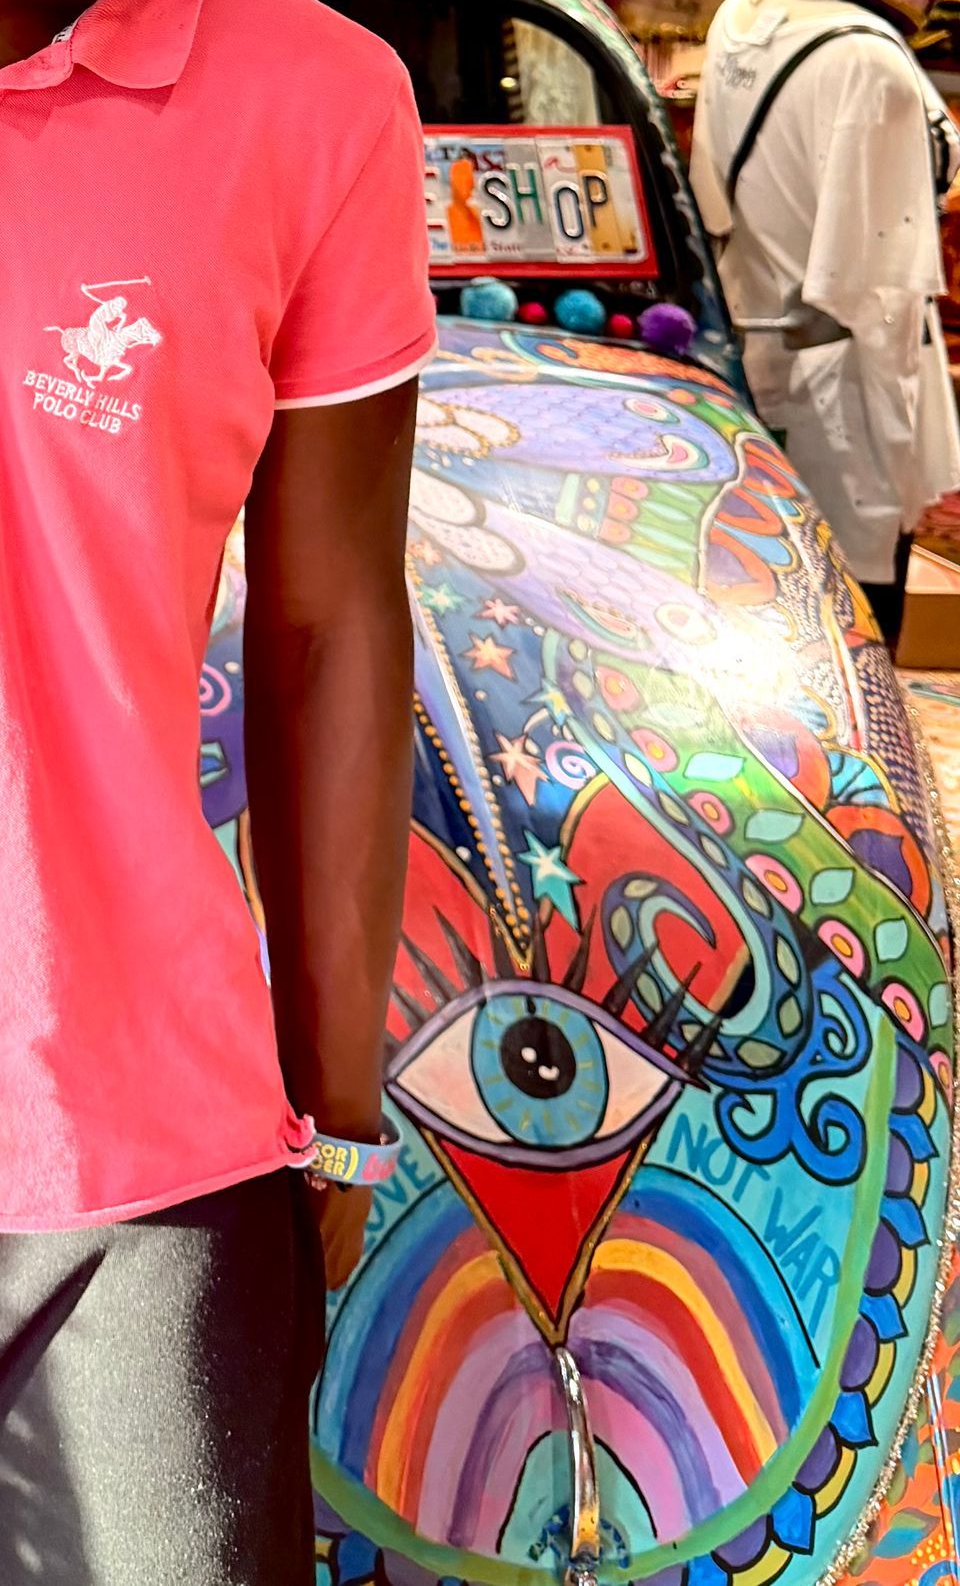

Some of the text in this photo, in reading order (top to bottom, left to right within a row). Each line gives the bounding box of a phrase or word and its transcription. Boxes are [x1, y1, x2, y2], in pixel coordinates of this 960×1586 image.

[480, 164, 608, 239] SHOP
[22, 369, 143, 421] BEVERLY HILLS
[33, 391, 122, 433] POLO CLUB
[666, 1112, 771, 1202] NOT
[763, 1186, 840, 1339] WAR
